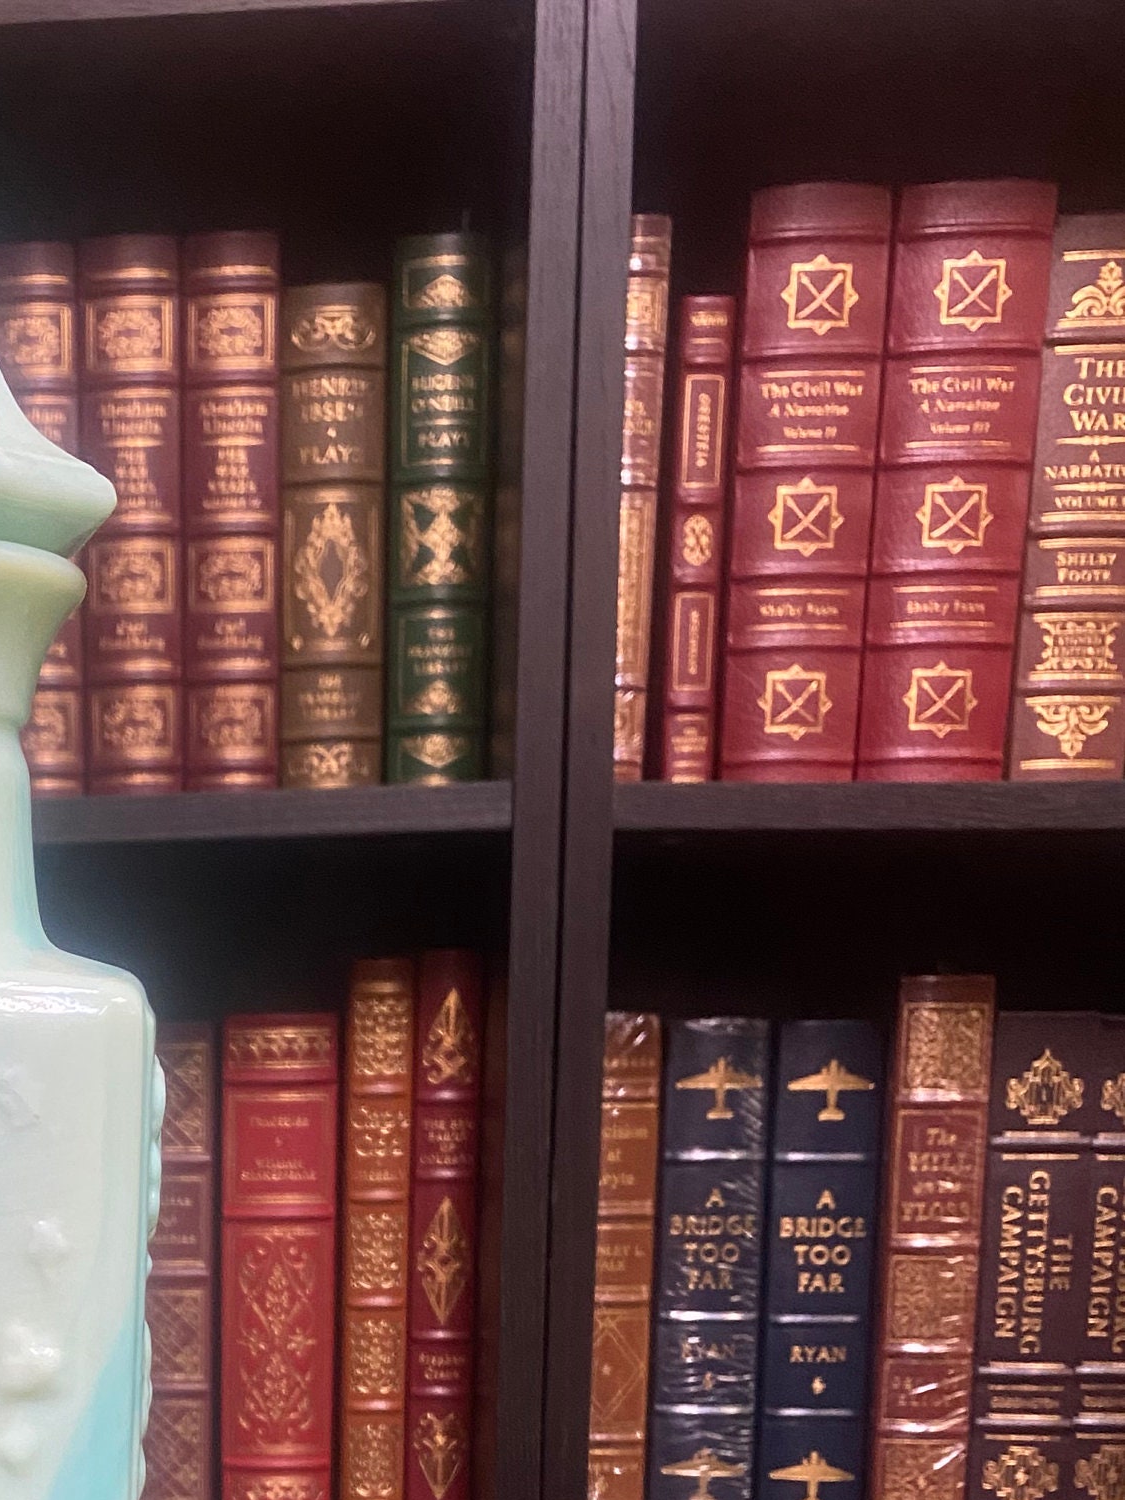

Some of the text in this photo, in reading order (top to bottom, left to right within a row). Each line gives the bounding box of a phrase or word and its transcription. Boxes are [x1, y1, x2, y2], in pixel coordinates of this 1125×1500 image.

[760, 381, 863, 399] The Civil War
[908, 377, 1014, 394] The Civil War
[1063, 383, 1125, 406] CIVI
[768, 402, 849, 418] A Narrative
[918, 399, 1001, 414] A Narrative
[1069, 409, 1125, 431] WAR
[1088, 450, 1100, 463] A
[1054, 495, 1117, 509] VOLUME
[1057, 551, 1116, 567] SHELBY
[1057, 567, 1111, 583] FOOTE
[926, 1127, 957, 1146] The
[705, 1188, 724, 1208] A
[815, 1189, 837, 1211] A
[669, 1214, 757, 1236] BRIDGE
[779, 1216, 867, 1239] BRIDGE
[683, 1242, 741, 1264] TOO
[794, 1244, 852, 1266] TOO
[994, 1186, 1024, 1338] CAMPAIGN
[1019, 1170, 1051, 1354] GETTYSBURG
[1048, 1234, 1073, 1291] THE
[1087, 1187, 1118, 1338] CAMPAIGN
[687, 1269, 734, 1291] FAR
[797, 1271, 845, 1294] FAR
[681, 1342, 737, 1362] RYAN
[789, 1345, 847, 1364] RYAN
